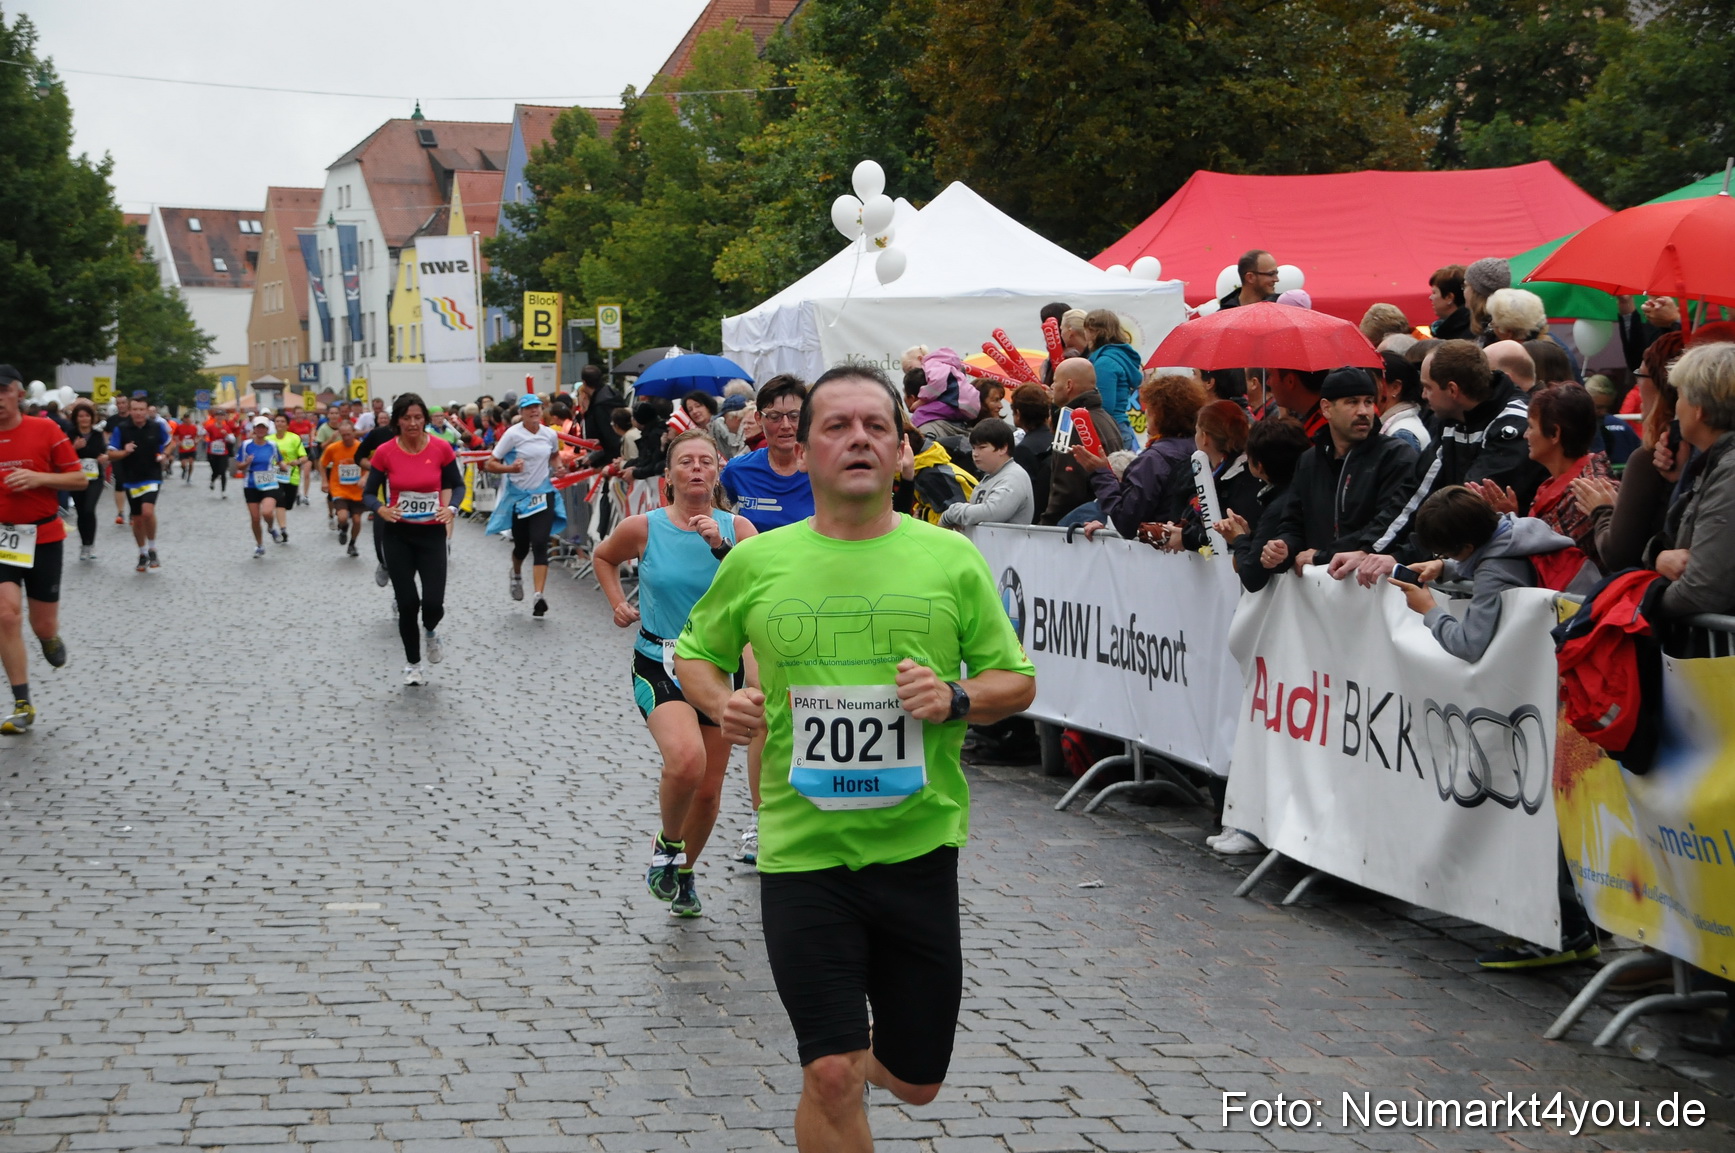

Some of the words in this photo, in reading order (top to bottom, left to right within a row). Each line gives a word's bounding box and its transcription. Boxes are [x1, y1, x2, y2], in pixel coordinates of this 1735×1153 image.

[528, 295, 558, 305] Block
[534, 310, 551, 337] B
[98, 384, 108, 397] C
[355, 386, 364, 398] C
[402, 499, 435, 513] 2997
[766, 593, 932, 658] OPF
[1033, 596, 1091, 661] BMW
[1096, 605, 1189, 692] Laufsport
[804, 658, 818, 666] und
[794, 697, 833, 710] PARTL
[837, 698, 900, 710] Neumarkt
[1250, 656, 1330, 746] Audi
[1342, 679, 1424, 780] BKK
[804, 715, 905, 763] 2021
[832, 775, 880, 793] Horst
